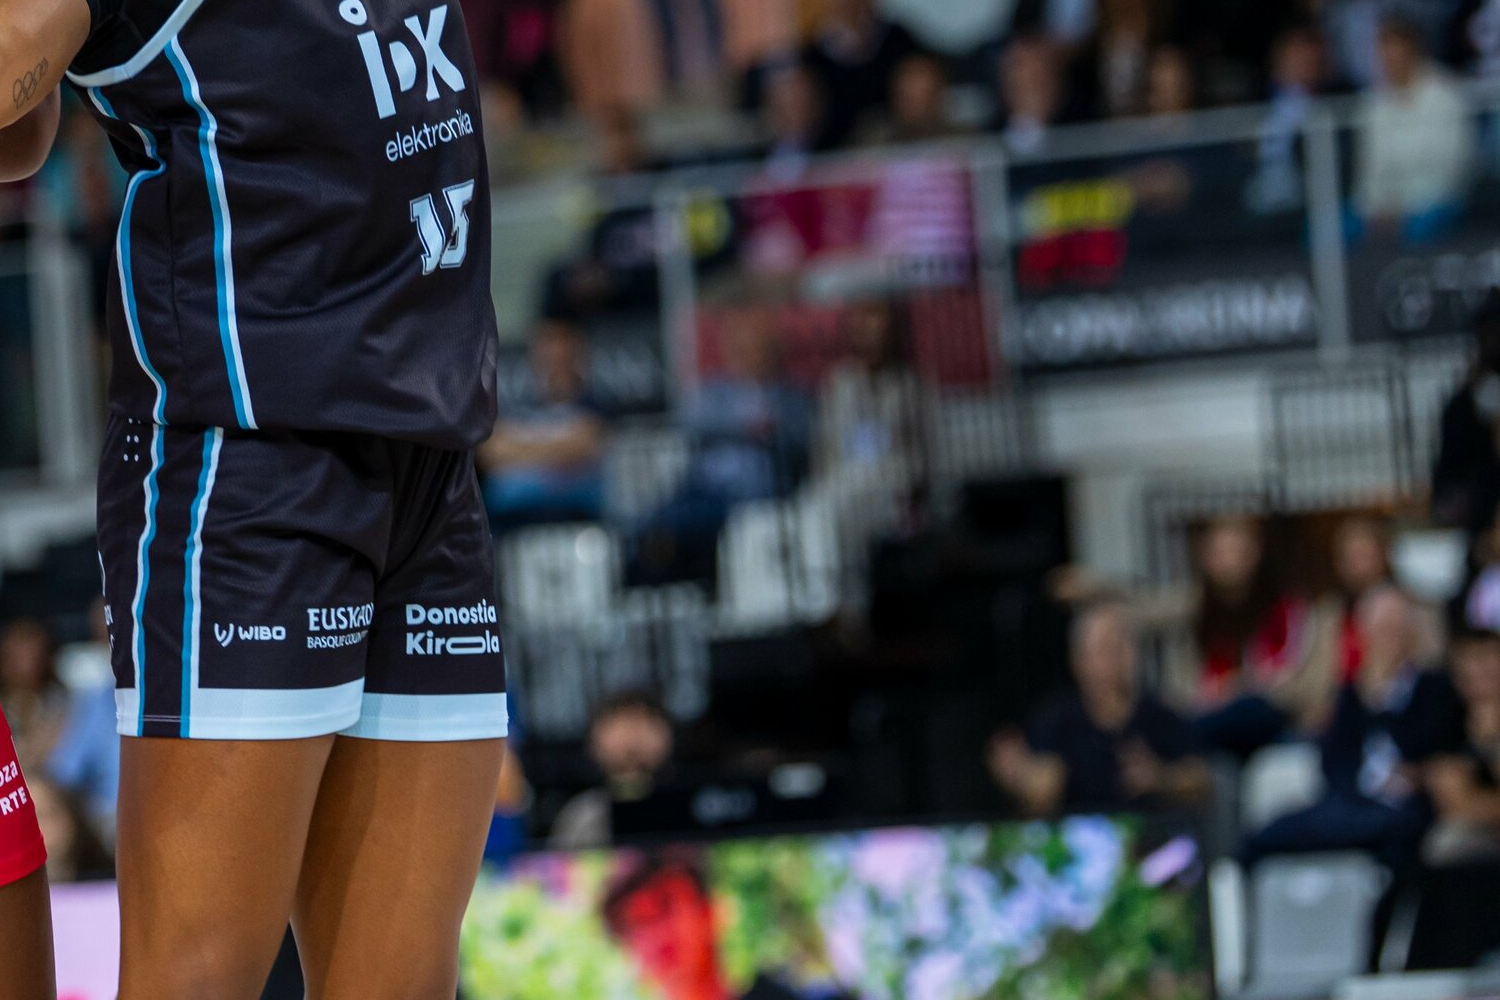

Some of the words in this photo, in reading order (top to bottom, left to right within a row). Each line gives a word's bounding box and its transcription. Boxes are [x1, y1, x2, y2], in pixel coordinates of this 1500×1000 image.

[385, 108, 474, 163] elektronika
[410, 179, 476, 276] 15
[238, 623, 286, 641] WIBO
[406, 599, 497, 625] Donostia
